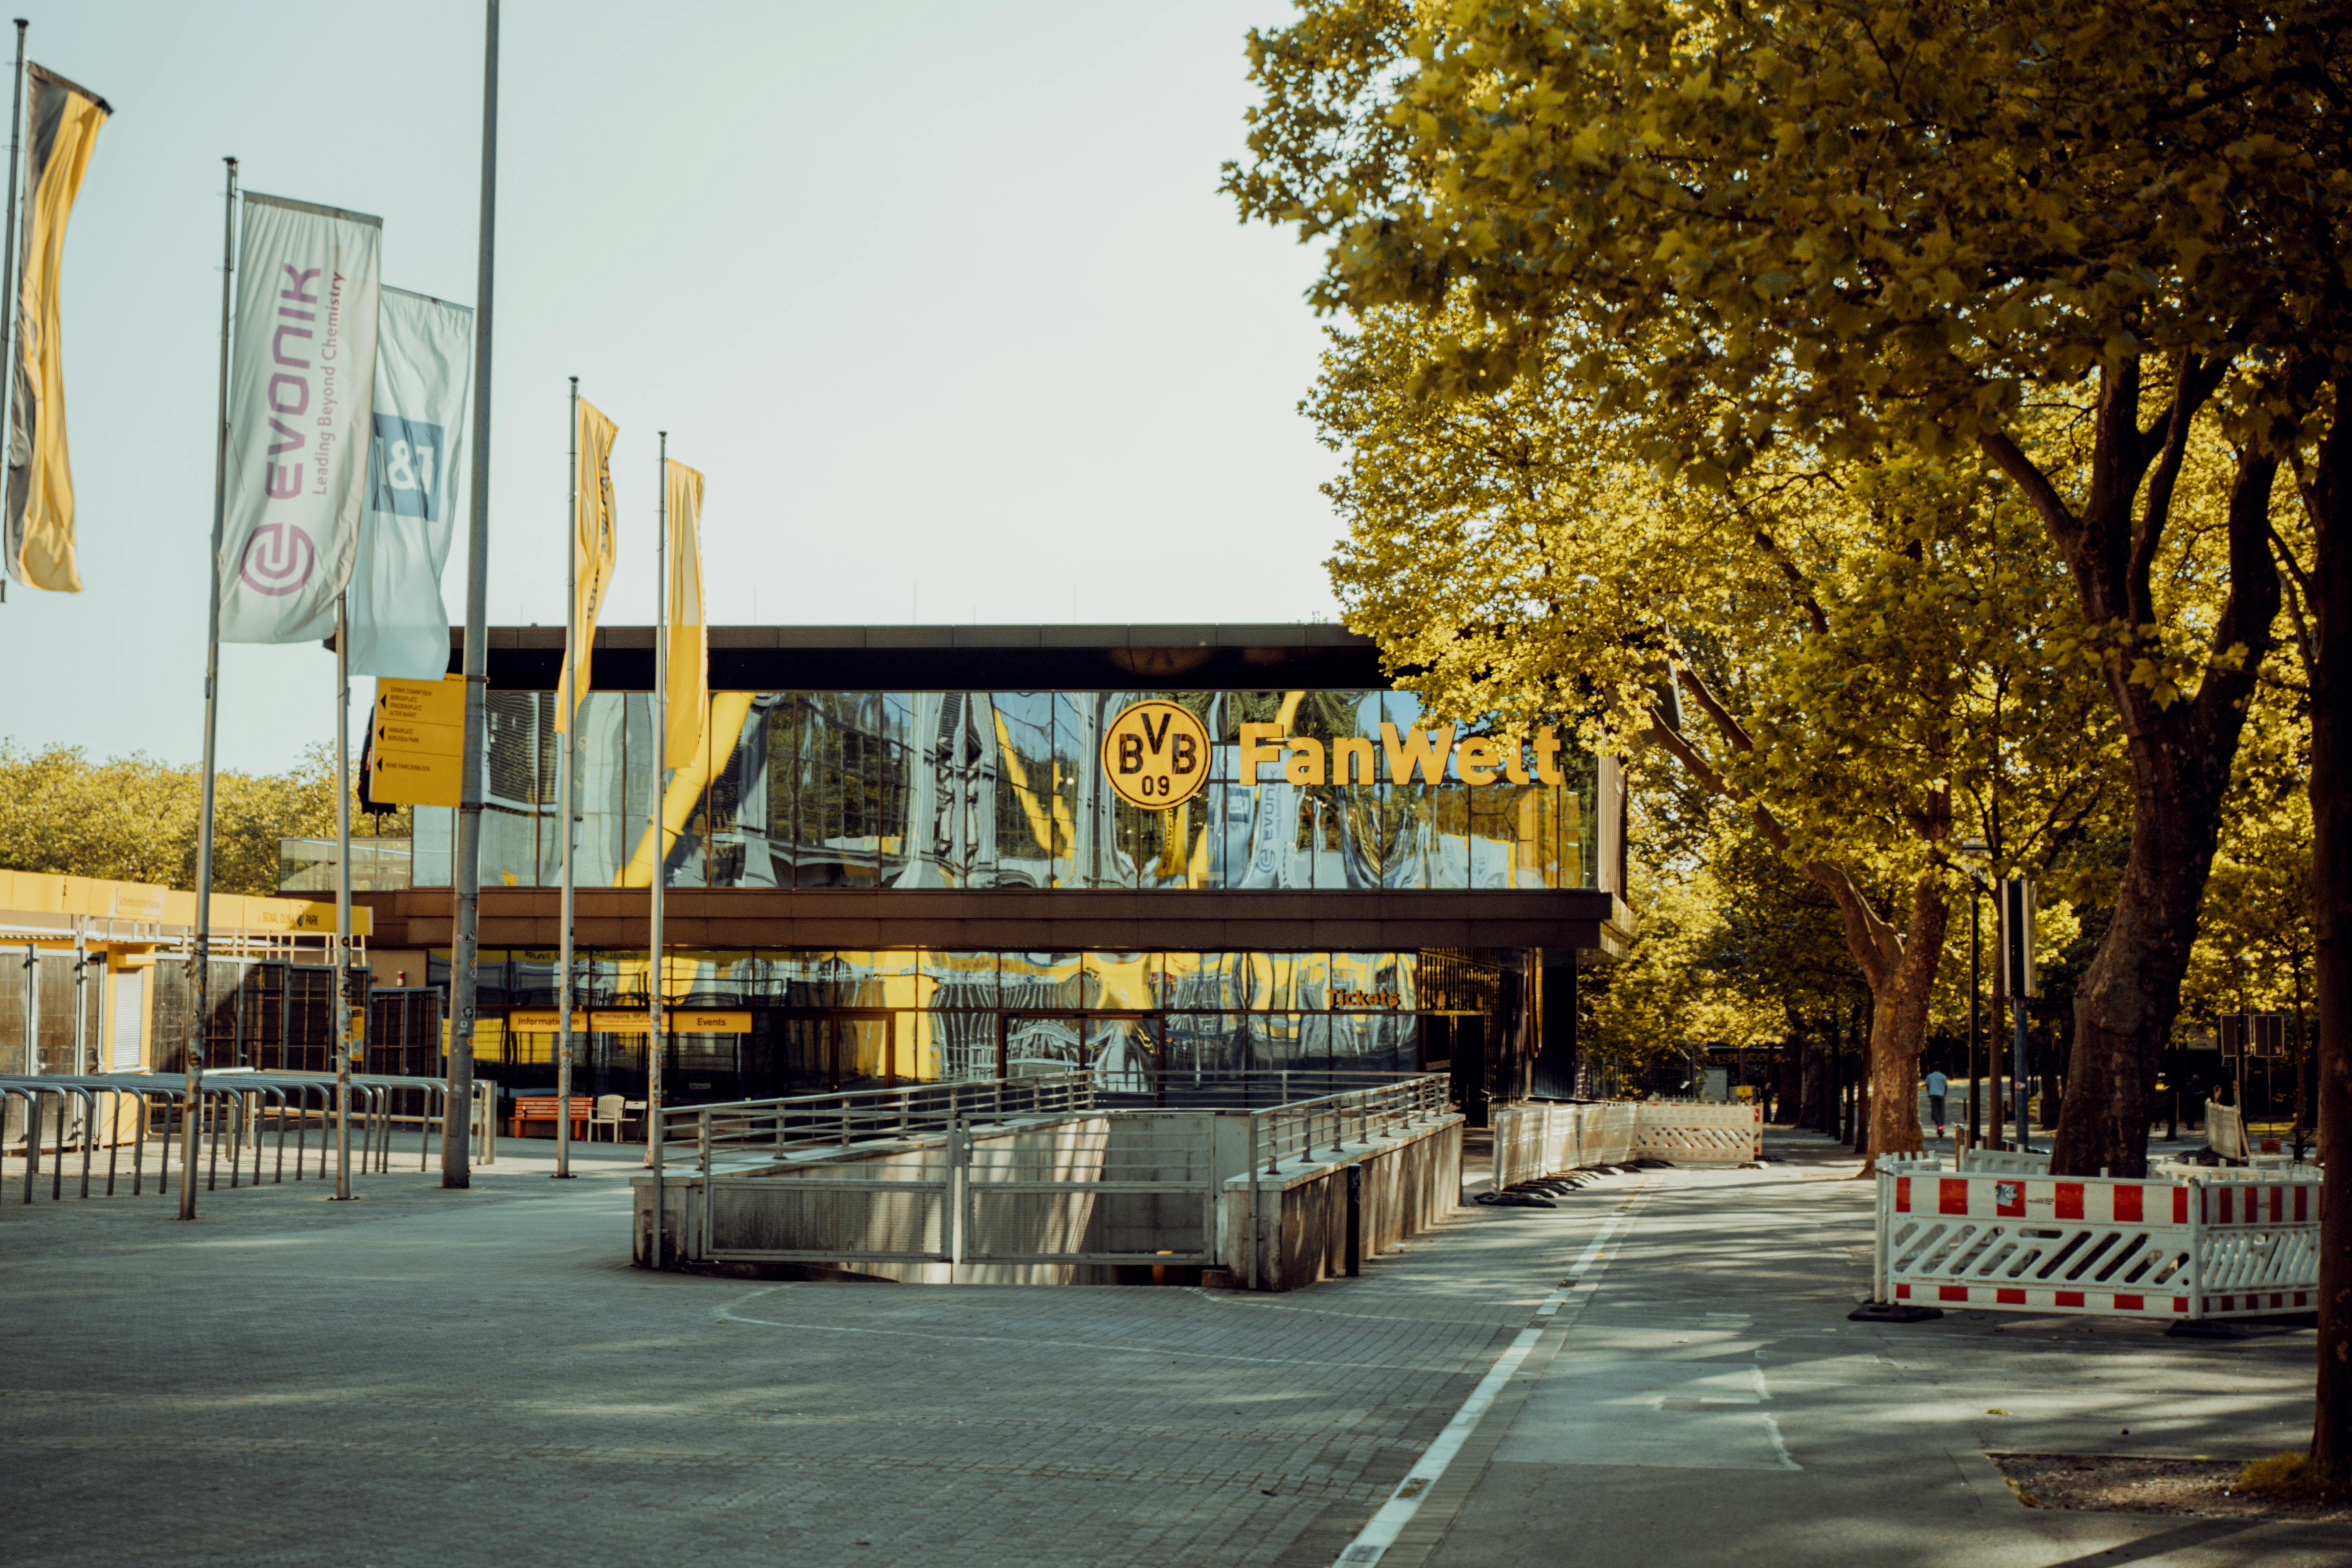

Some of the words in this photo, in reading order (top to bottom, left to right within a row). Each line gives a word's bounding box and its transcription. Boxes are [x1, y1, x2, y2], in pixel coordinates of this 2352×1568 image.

[321, 271, 346, 361] Chemistry
[265, 263, 321, 499] EVONIK
[317, 366, 338, 426] Beyond
[312, 431, 336, 495] Leading
[390, 702, 422, 711] FRIEDENSPLATZ
[1119, 713, 1196, 774] BVB
[1239, 722, 1561, 785] FanWelt
[1142, 775, 1169, 796] 09
[306, 914, 319, 926] PARK
[697, 1018, 726, 1026] Events
[1326, 989, 1400, 1006] Tickets
